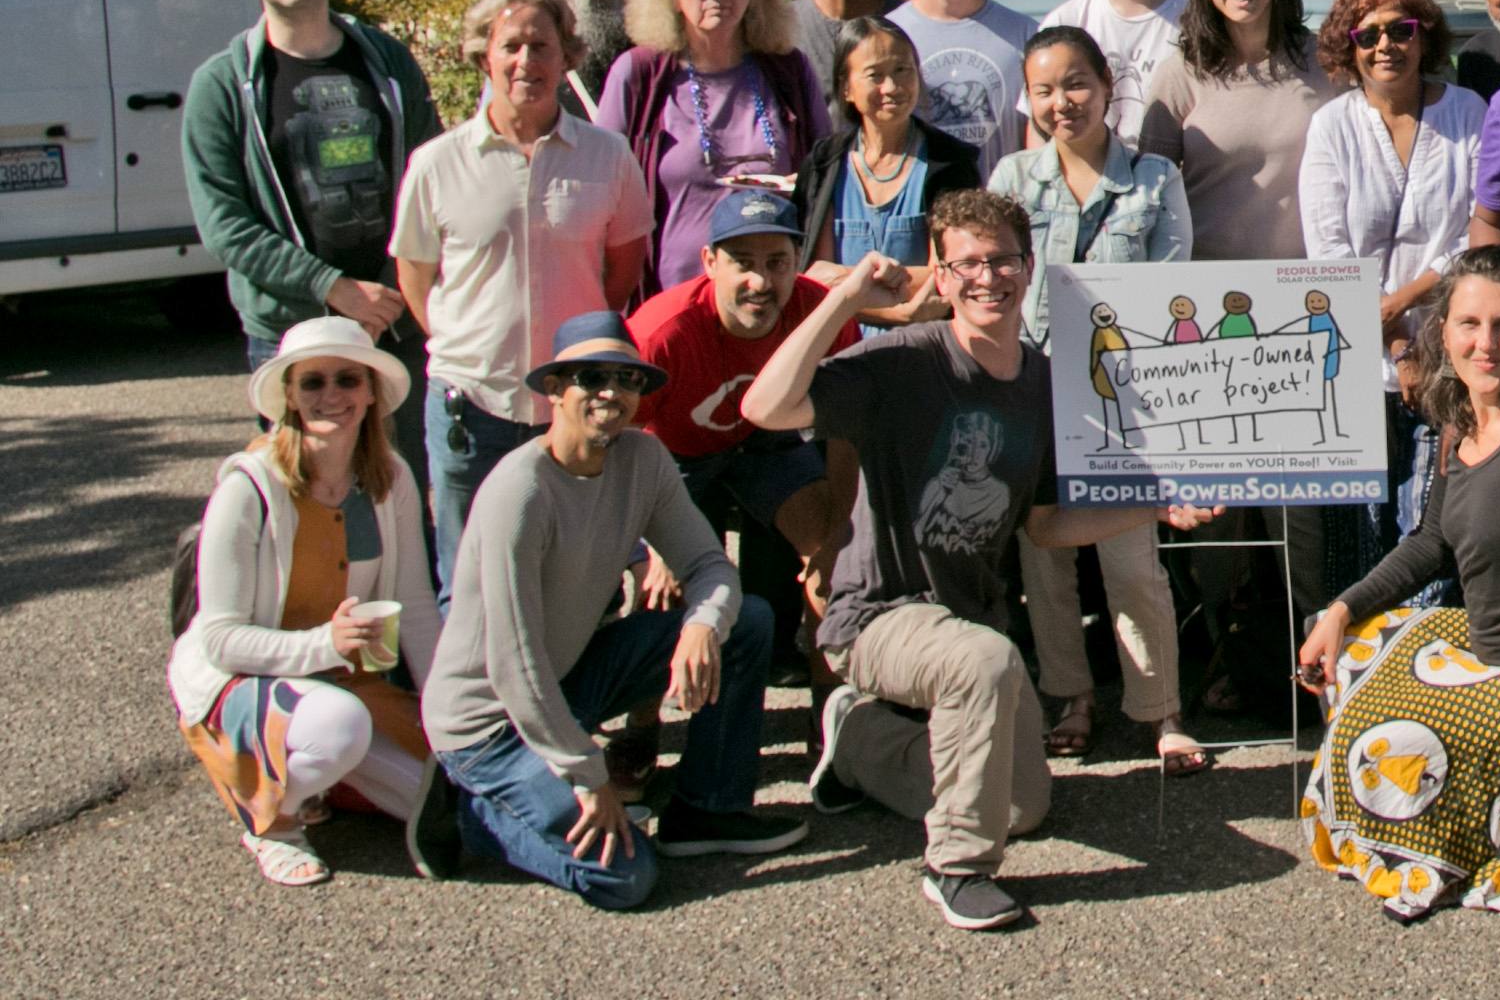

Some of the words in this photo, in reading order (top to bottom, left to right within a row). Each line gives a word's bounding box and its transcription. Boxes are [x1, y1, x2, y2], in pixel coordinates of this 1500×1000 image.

[967, 54, 1002, 91] RIVER
[1277, 267, 1318, 276] PEOPLE
[1321, 265, 1361, 274] POWER
[1277, 276, 1303, 284] SOLAR
[1305, 274, 1362, 283] COOPERATIVE
[1224, 369, 1311, 406] project!
[1089, 460, 1118, 471] Build
[1122, 459, 1186, 471] Community
[1189, 459, 1225, 468] Power
[1246, 457, 1286, 469] YOUR
[1289, 457, 1320, 468] Roof!
[1327, 456, 1358, 466] Visit:
